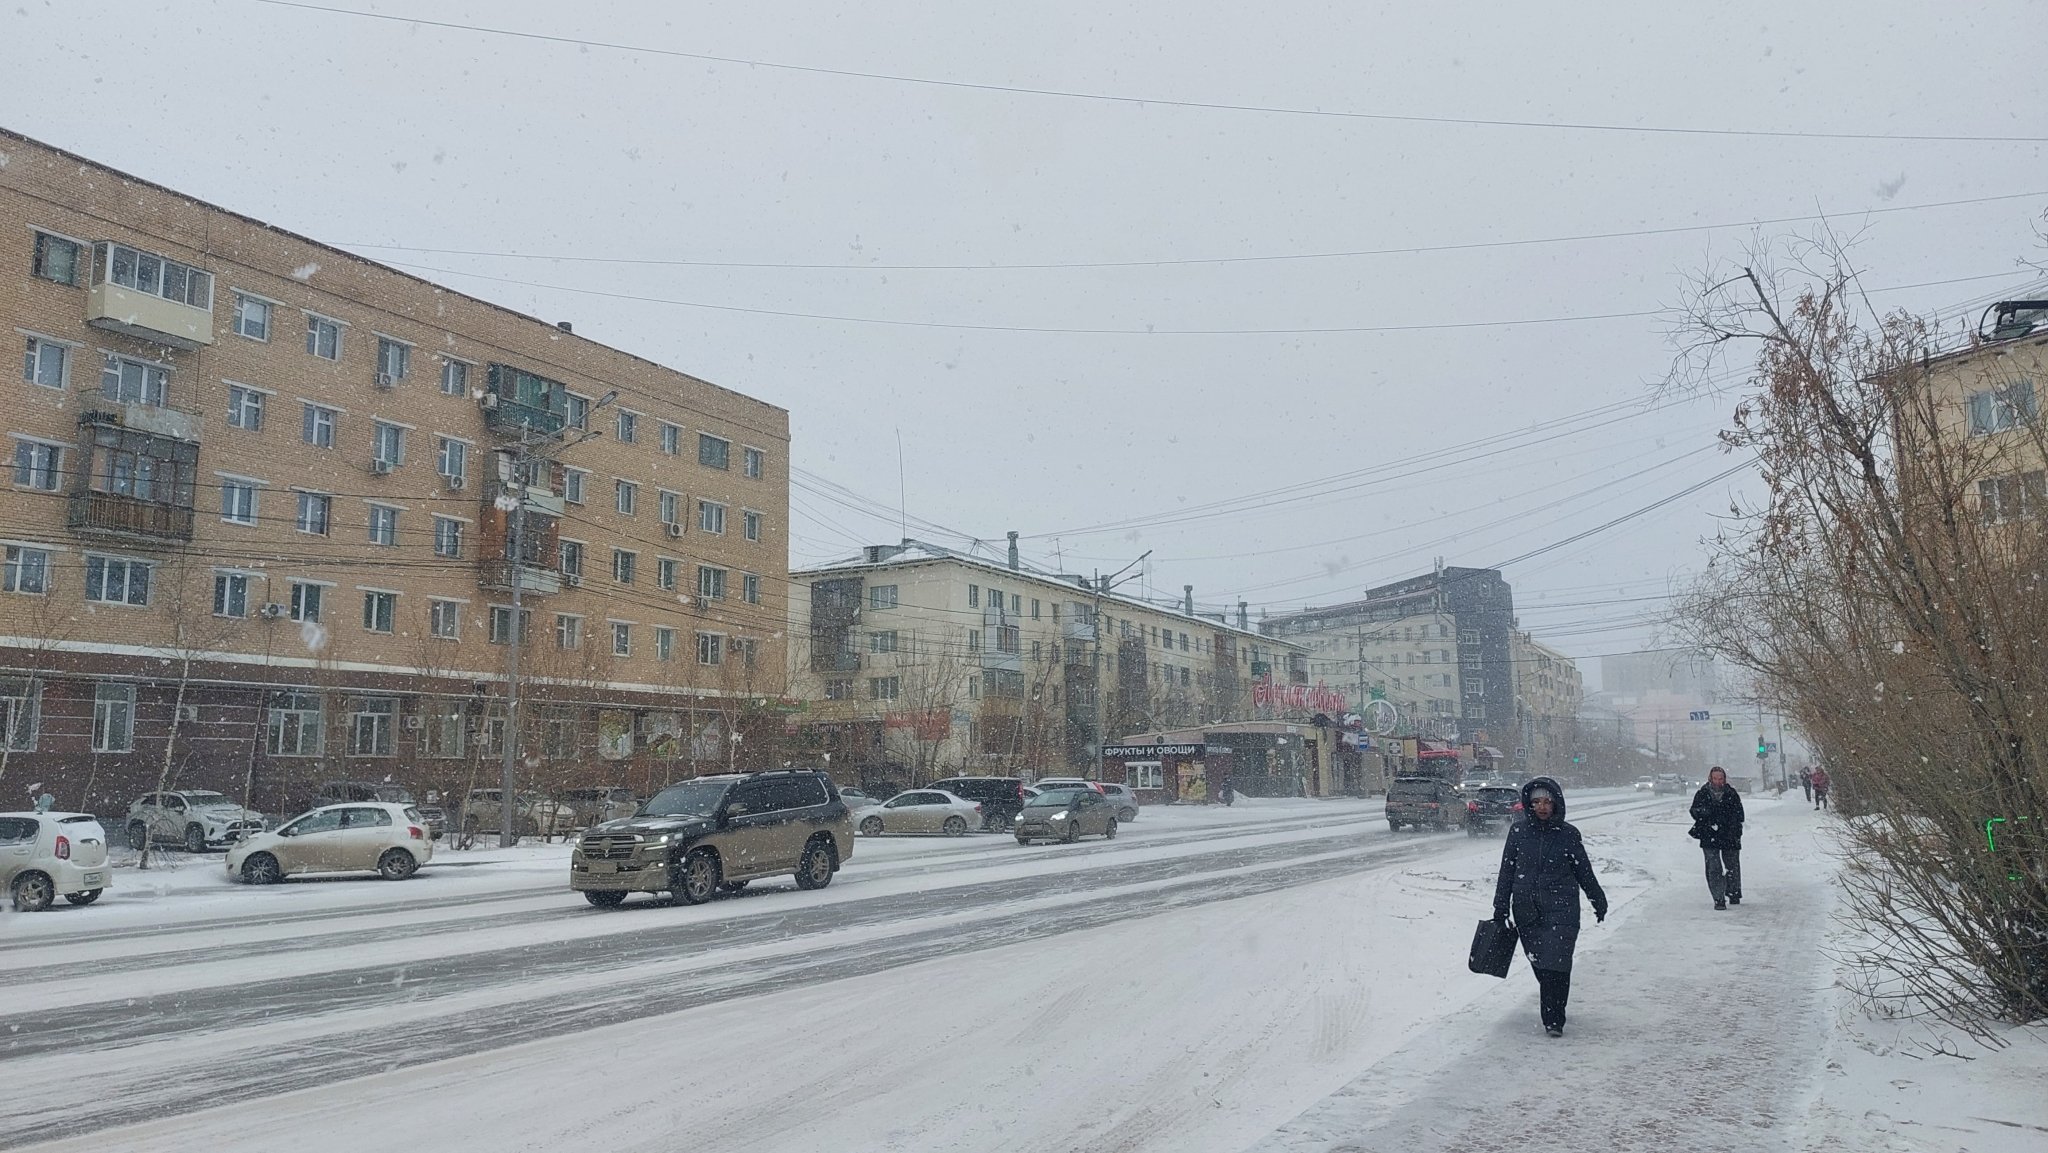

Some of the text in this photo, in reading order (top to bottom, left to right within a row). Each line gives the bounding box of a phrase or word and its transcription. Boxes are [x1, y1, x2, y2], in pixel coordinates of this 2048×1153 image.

[1104, 746, 1195, 756] ФРУКТЫ И ОВОЩИ
